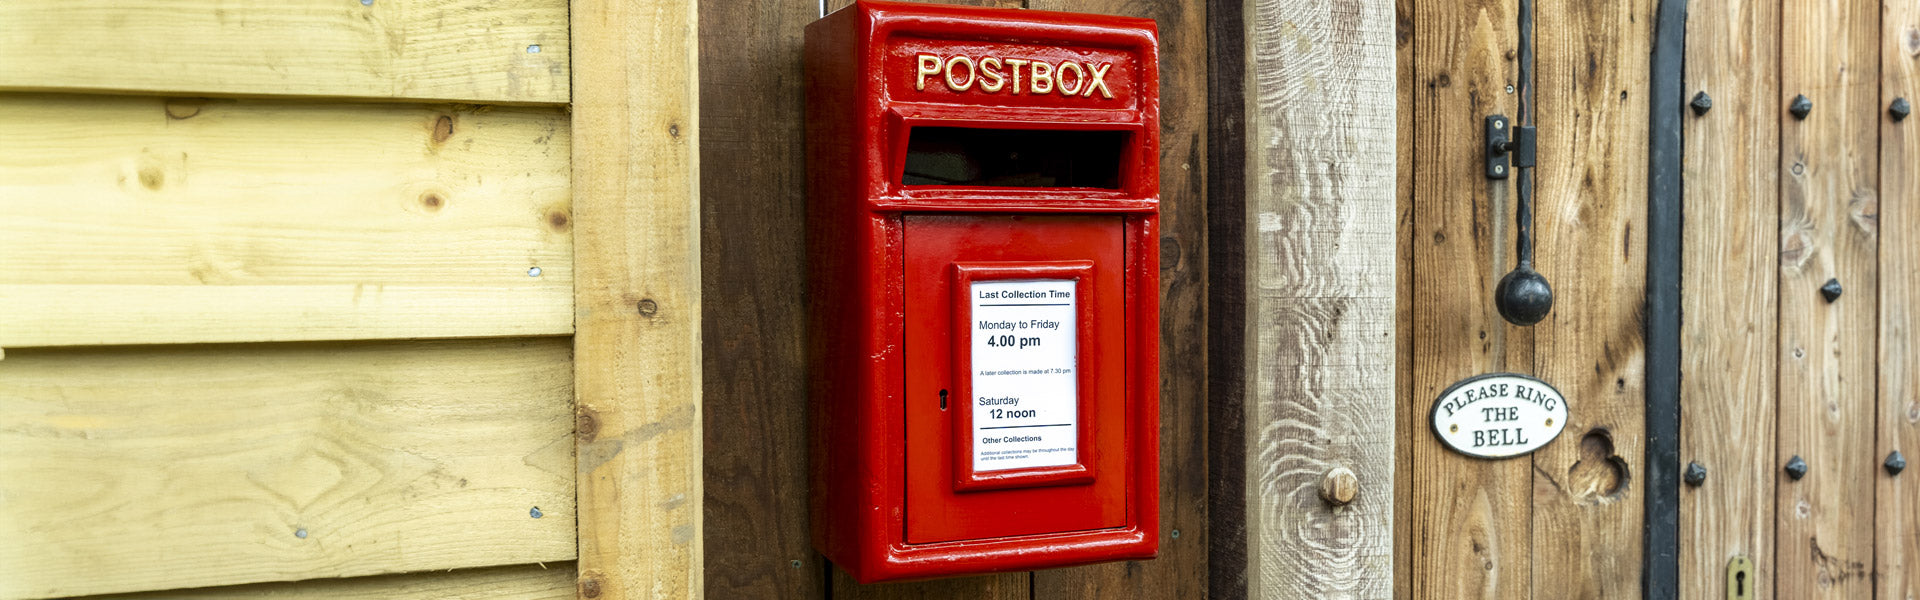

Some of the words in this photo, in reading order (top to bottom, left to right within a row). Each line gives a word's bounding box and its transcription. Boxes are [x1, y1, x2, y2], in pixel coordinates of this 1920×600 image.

[916, 54, 1113, 98] POSTBOX
[1001, 290, 1046, 298] Collection
[1049, 290, 1070, 298] Time
[979, 321, 1016, 331] Monday
[1019, 320, 1027, 329] to
[1031, 320, 1059, 330] Friday
[988, 335, 1015, 347] 4.00
[1020, 337, 1041, 349] pm
[979, 397, 1019, 407] Saturday
[1443, 384, 1508, 416] PLEASE
[1515, 385, 1556, 411] RING
[990, 409, 1002, 419] 12
[1007, 410, 1036, 418] noon
[1482, 407, 1519, 422] THE
[1473, 428, 1528, 448] BELL
